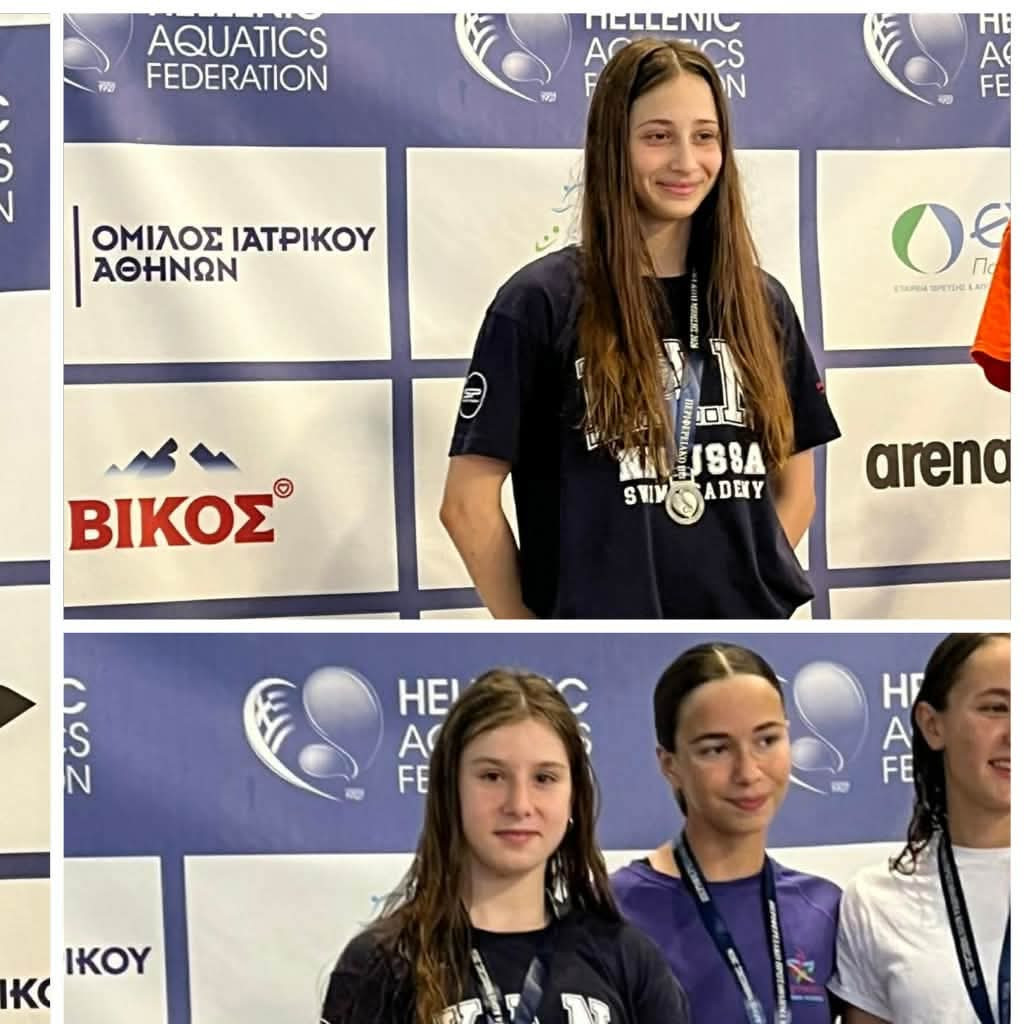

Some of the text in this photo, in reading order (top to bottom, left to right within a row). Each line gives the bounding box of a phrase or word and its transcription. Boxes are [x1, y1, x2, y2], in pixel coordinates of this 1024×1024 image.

[147, 25, 328, 58] AQUATICS
[146, 63, 328, 92] FEDERATION
[92, 225, 376, 252] ΟΜΙΛΟΣ ΙΑΤΡΙΚΟΥ
[92, 256, 238, 282] ΑΘΗΝΩΝ
[68, 494, 274, 551] ΒΙΚΟΣ
